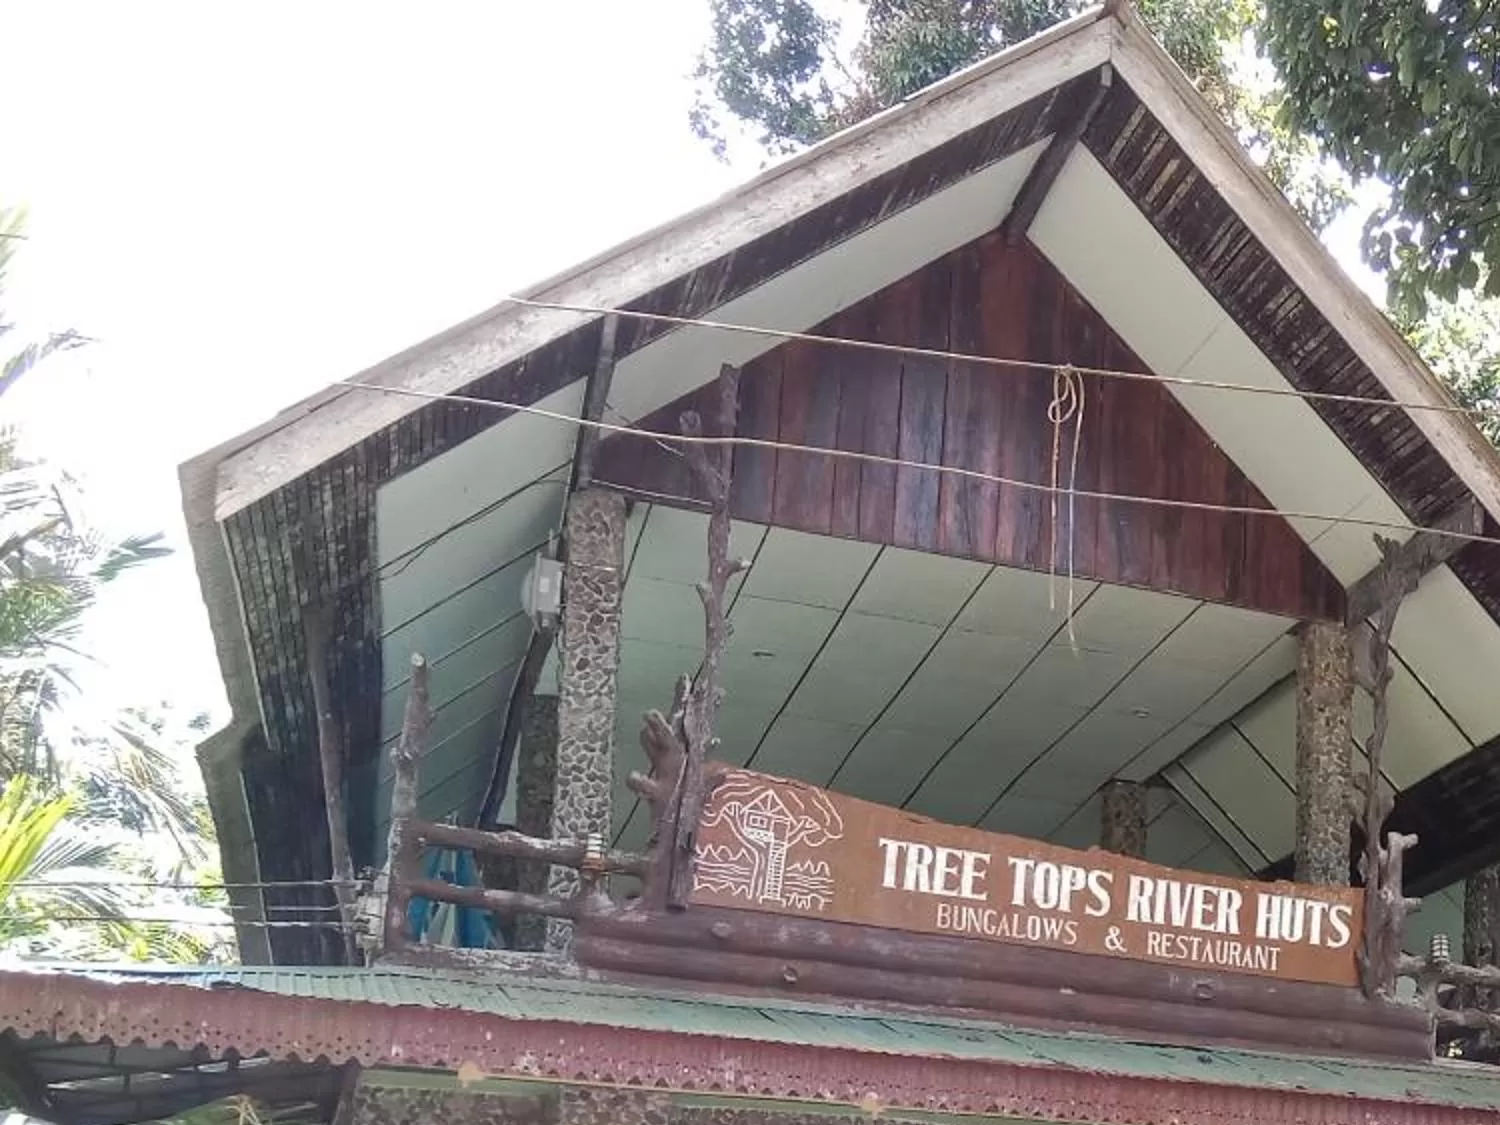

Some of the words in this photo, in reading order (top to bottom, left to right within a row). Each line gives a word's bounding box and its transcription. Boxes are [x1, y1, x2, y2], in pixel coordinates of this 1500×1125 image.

[877, 836, 991, 902] TREE
[1007, 855, 1113, 920] TOPS
[1126, 874, 1242, 937] RIVER
[1254, 895, 1354, 951] HUTS
[936, 902, 1078, 947] BUNGALOWS
[1105, 925, 1128, 953] &
[1146, 930, 1282, 973] RESTAURANT
